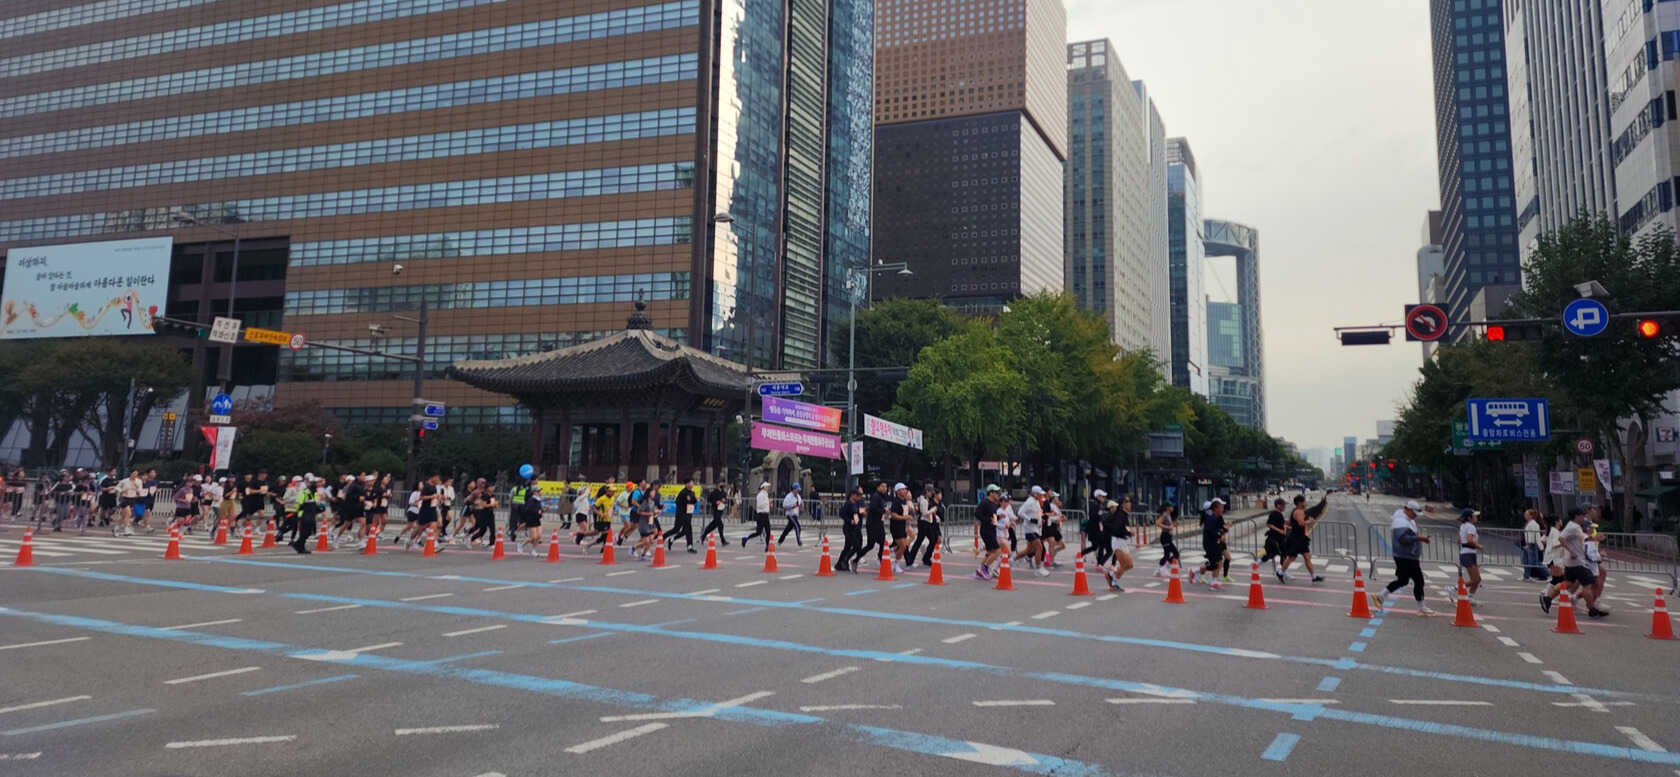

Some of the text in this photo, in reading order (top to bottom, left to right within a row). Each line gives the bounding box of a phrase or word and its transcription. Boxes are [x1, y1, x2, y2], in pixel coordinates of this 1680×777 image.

[94, 276, 123, 288] 아름다운
[126, 274, 155, 287] 일이란다
[293, 337, 302, 346] 50
[1482, 428, 1536, 438] 중앙차로버스전용
[1580, 442, 1590, 450] 50
